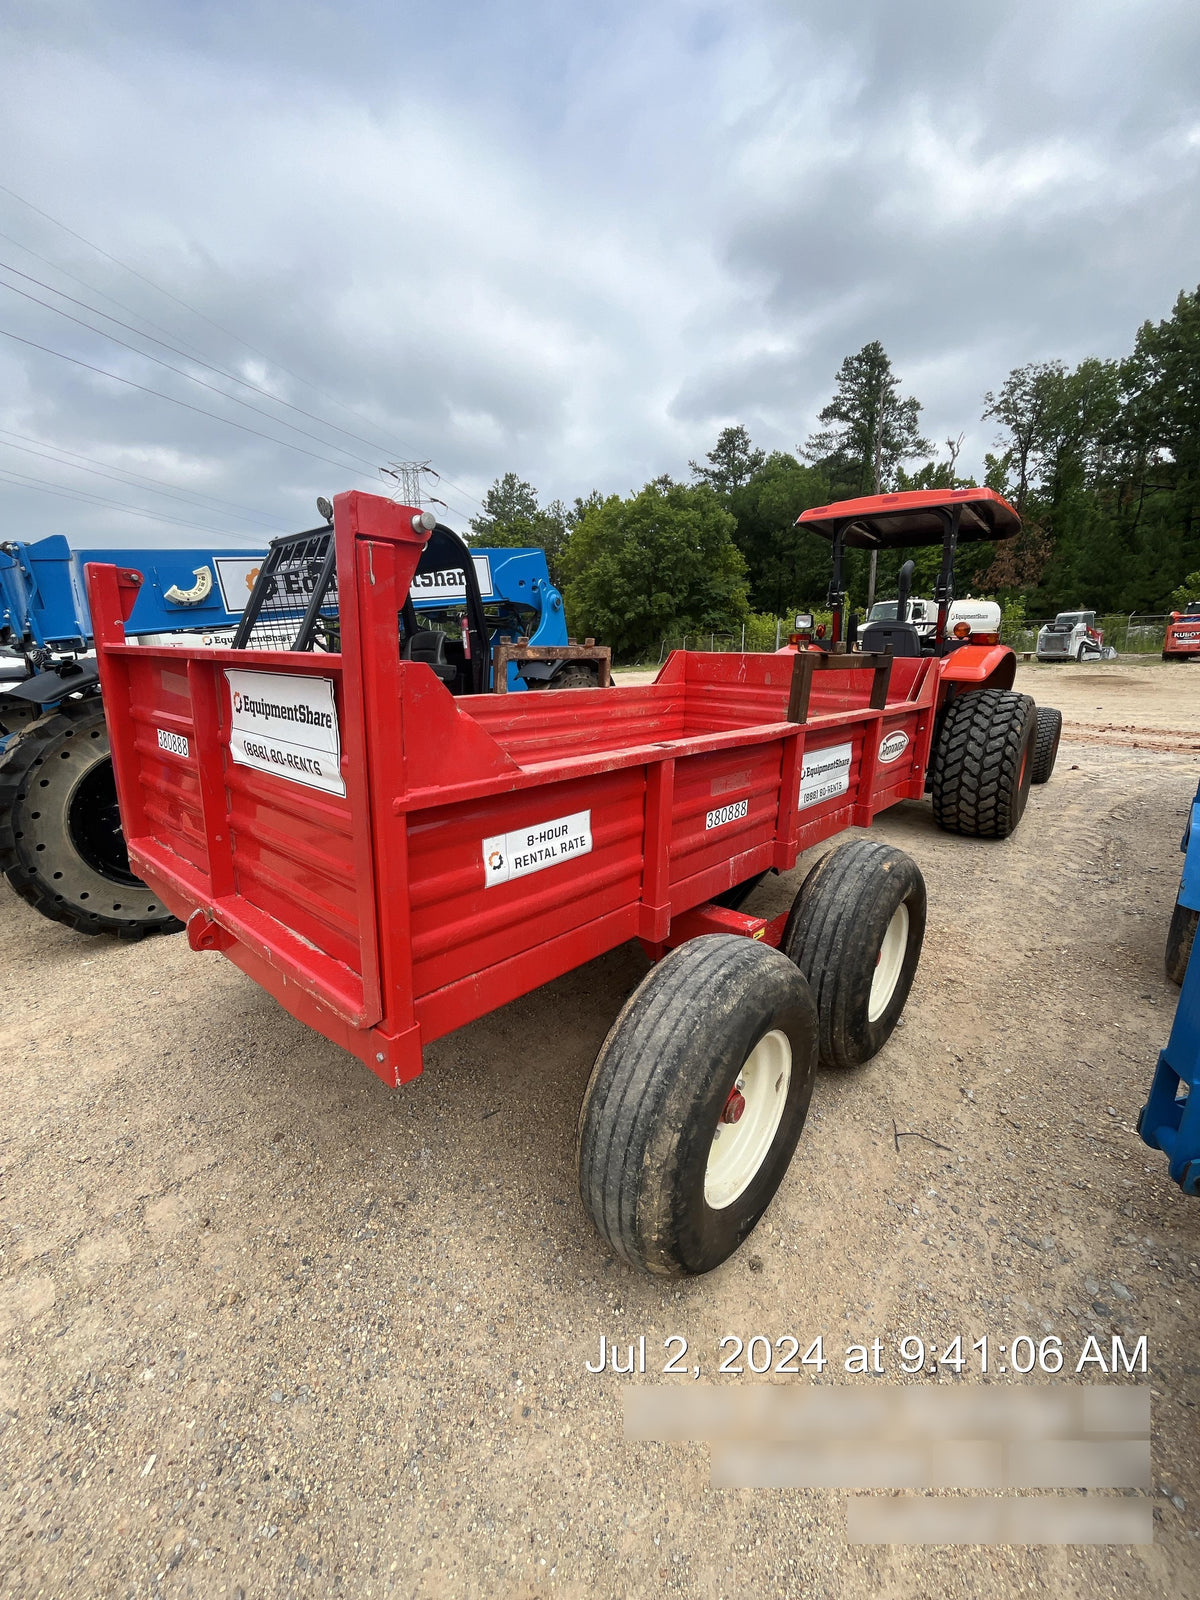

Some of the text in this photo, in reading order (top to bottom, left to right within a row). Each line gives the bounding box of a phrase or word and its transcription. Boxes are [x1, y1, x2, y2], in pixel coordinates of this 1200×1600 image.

[243, 695, 332, 728] EquipmentShare
[158, 730, 188, 756] 380888
[243, 740, 323, 776] (888) 80-RENTS
[806, 758, 850, 778] EquipmentShare
[707, 801, 747, 828] 380888
[527, 824, 568, 846] 8-HOUR
[514, 836, 586, 869] RENTAL RATE
